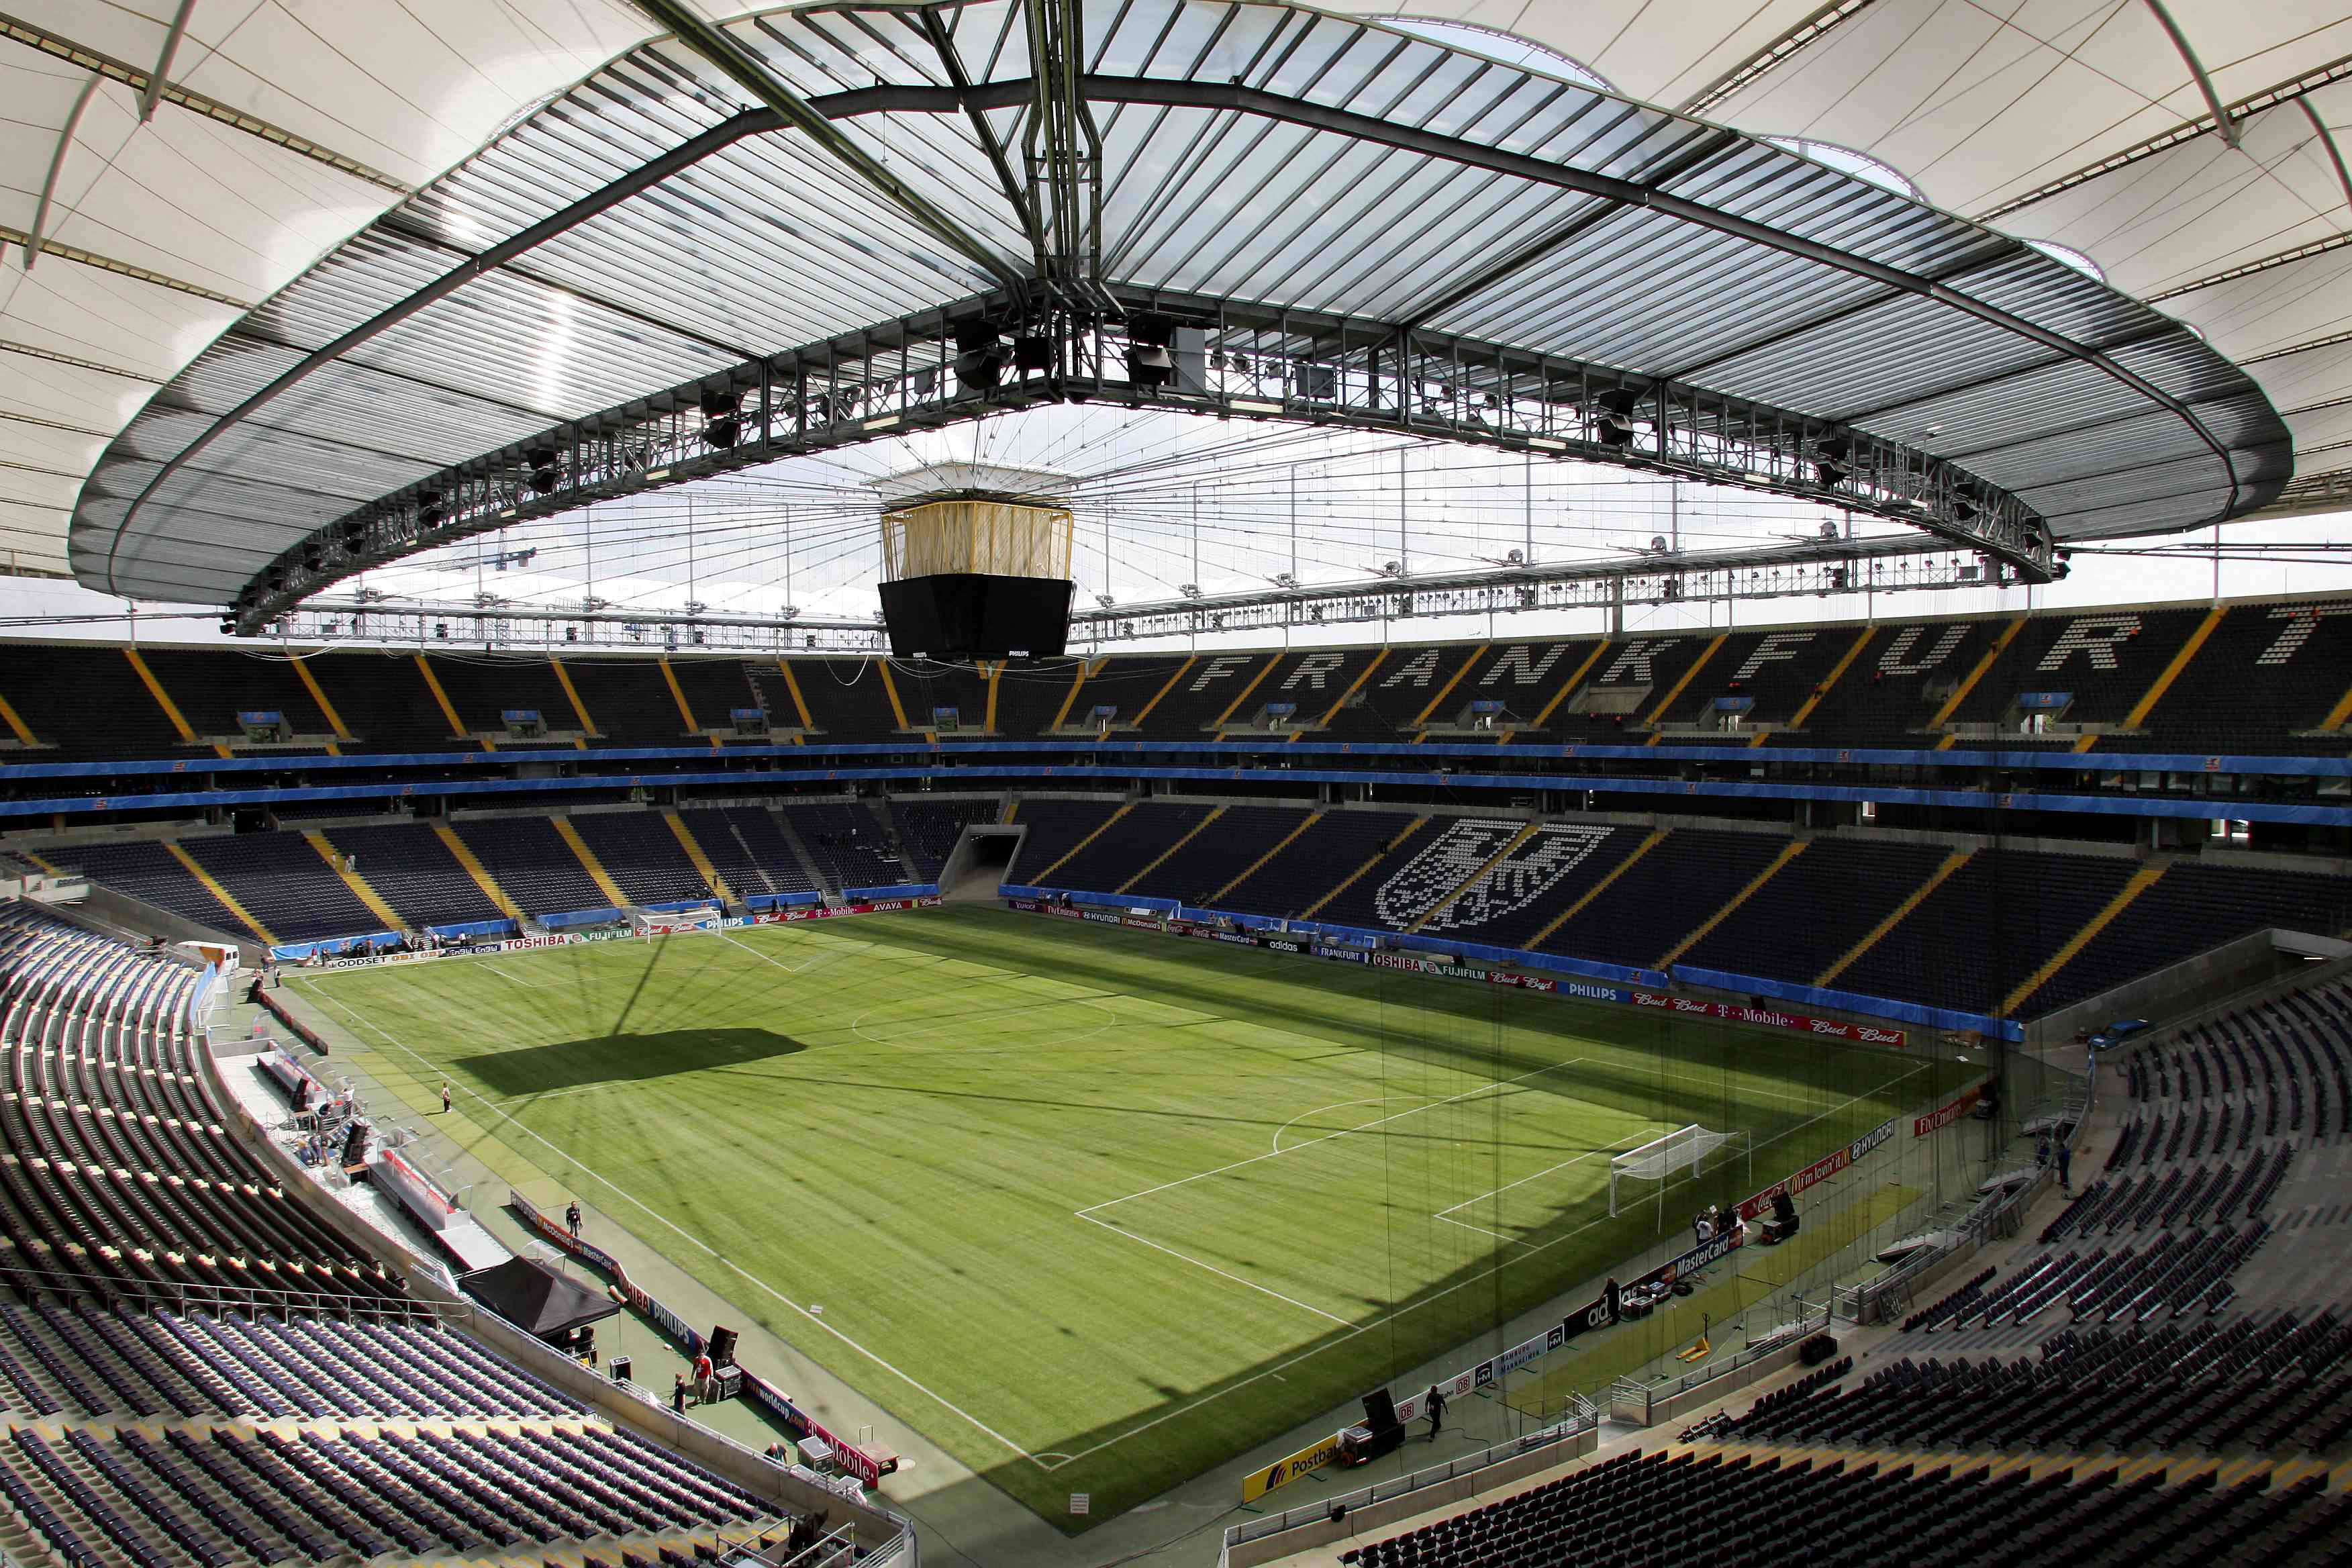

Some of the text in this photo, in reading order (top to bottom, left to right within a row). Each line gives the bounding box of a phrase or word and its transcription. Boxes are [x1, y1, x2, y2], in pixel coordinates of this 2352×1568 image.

[873, 902, 903, 912] AVAYA
[706, 917, 744, 930] PHILIPS
[757, 912, 808, 924] Bud Bud
[1091, 912, 1120, 924] HYUNDAI
[1127, 918, 1161, 929] McDonald's
[589, 928, 633, 941] FUJIFILM
[1219, 932, 1249, 944] MasterCard
[505, 935, 565, 950] TOSHIBA
[1269, 940, 1298, 952] adidas
[338, 957, 387, 967] ODDSET
[1320, 947, 1361, 962] FRANKFURT
[1375, 954, 1421, 971] OSHIBA
[1442, 966, 1485, 981] FUJIFILM
[1490, 971, 1553, 990] Bud Bud
[1569, 982, 1616, 1001] PHILIPS
[1634, 993, 1708, 1013] Bud Bud
[1810, 1020, 1898, 1044] Bud Bud
[1861, 1120, 1894, 1153] HYUNDAI
[1815, 1157, 1834, 1181] lovin'
[583, 1246, 612, 1271] MasterCard
[1677, 1236, 1729, 1279] MasterCard
[654, 1306, 689, 1344] PHILIPS
